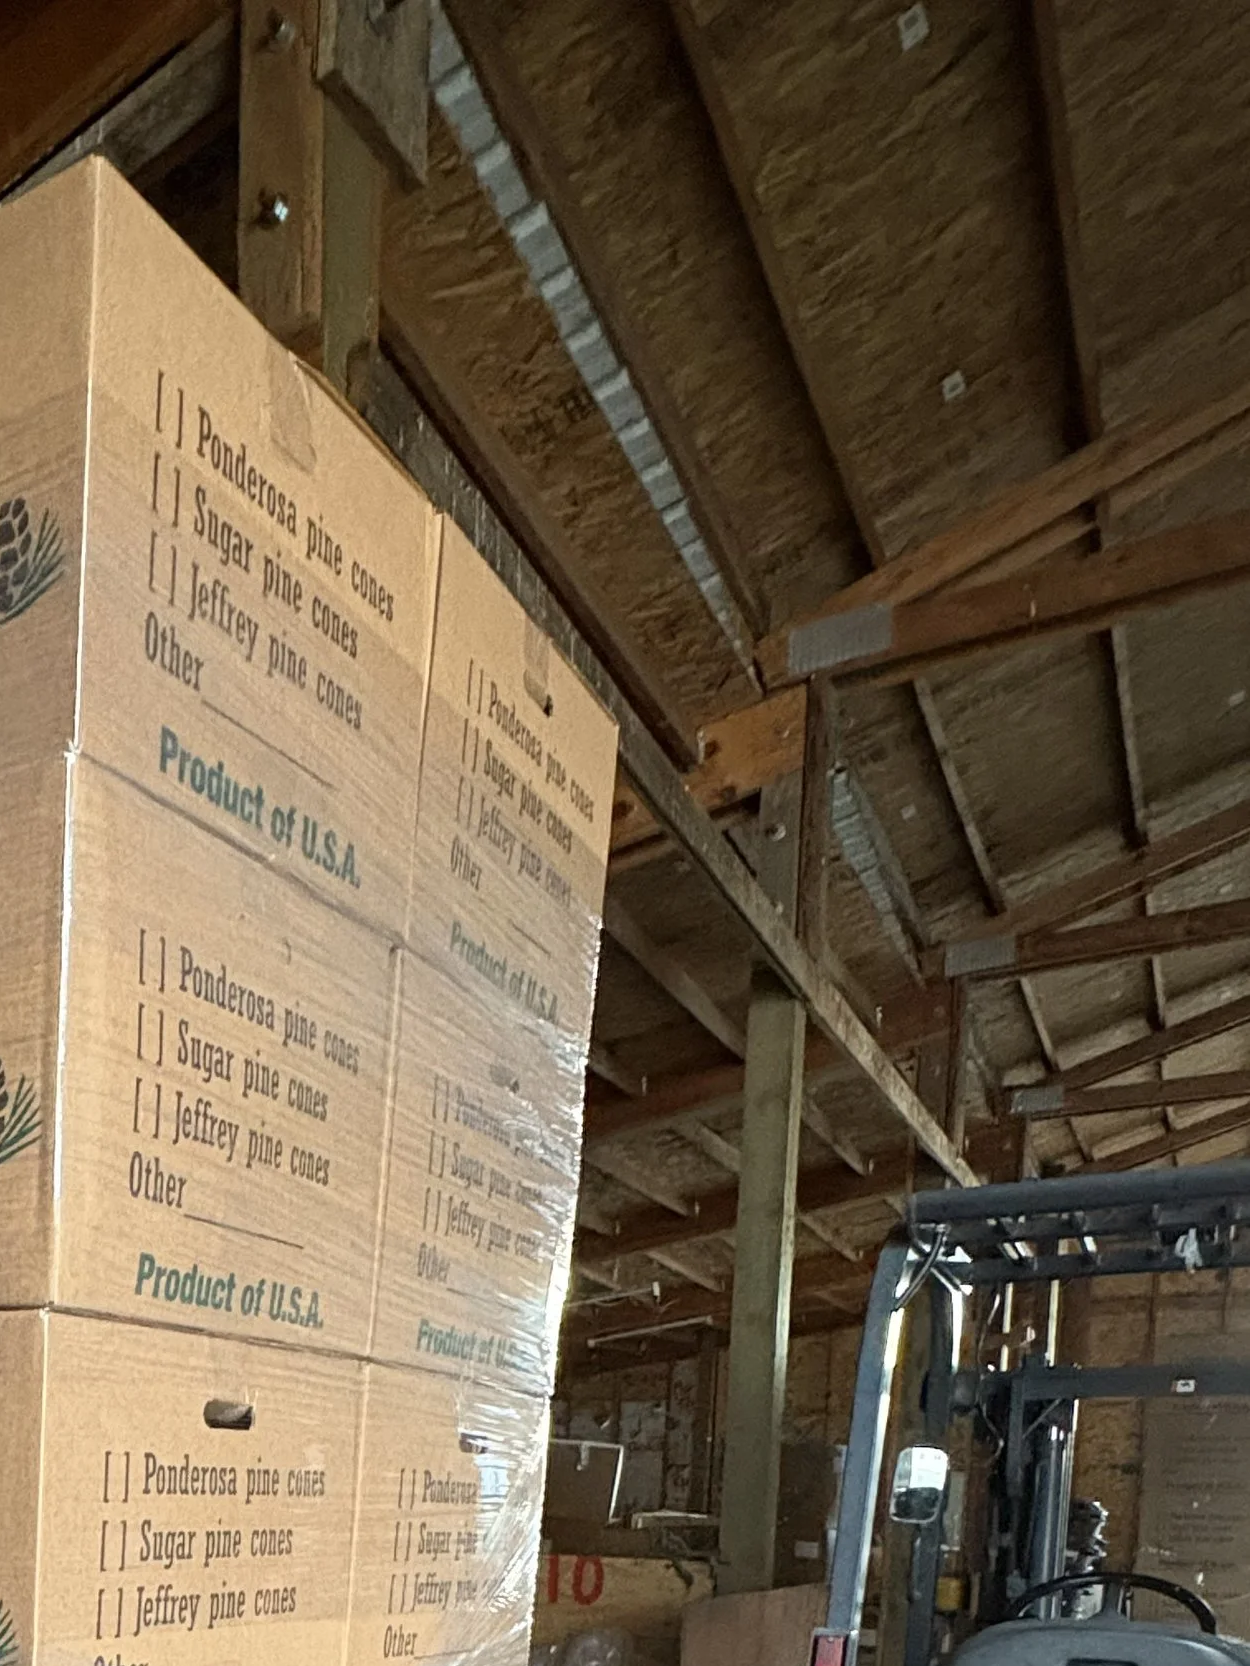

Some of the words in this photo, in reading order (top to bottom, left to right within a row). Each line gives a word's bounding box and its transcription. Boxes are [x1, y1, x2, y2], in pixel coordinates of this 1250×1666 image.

[198, 404, 297, 538] Ponderosa
[305, 514, 343, 577] pine
[351, 559, 394, 622] cones
[194, 485, 253, 574] Sugar
[263, 550, 302, 613] pine
[312, 595, 358, 659] cones
[145, 611, 204, 691] Other
[188, 561, 259, 662] Jeffrey
[267, 630, 307, 690] pine
[316, 672, 362, 730] cones
[159, 724, 264, 831] Product
[270, 805, 297, 848] of
[302, 815, 361, 889] U.S.A.
[483, 738, 516, 799] Sugar
[179, 945, 275, 1031] Ponderosa
[282, 1001, 317, 1050] pine
[324, 1028, 360, 1076] cones
[177, 1018, 234, 1083] Sugar
[242, 1049, 279, 1101] pine
[287, 1077, 329, 1122] cones
[173, 1090, 239, 1163] Jeffrey
[246, 1120, 283, 1169] pine
[290, 1144, 330, 1187] cones
[129, 1150, 187, 1209] Other
[134, 1251, 236, 1313] Product
[240, 1278, 265, 1317] of
[269, 1281, 323, 1329] U.S.A.
[142, 1452, 237, 1496] Ponderosa
[246, 1456, 279, 1504] pine
[287, 1467, 325, 1497] cones
[140, 1519, 197, 1570] Sugar
[204, 1518, 242, 1568] pine
[250, 1528, 293, 1557] cones
[133, 1584, 201, 1637] Jeffrey
[208, 1580, 246, 1629] pine
[254, 1585, 297, 1616] cones
[383, 1624, 418, 1659] Other
